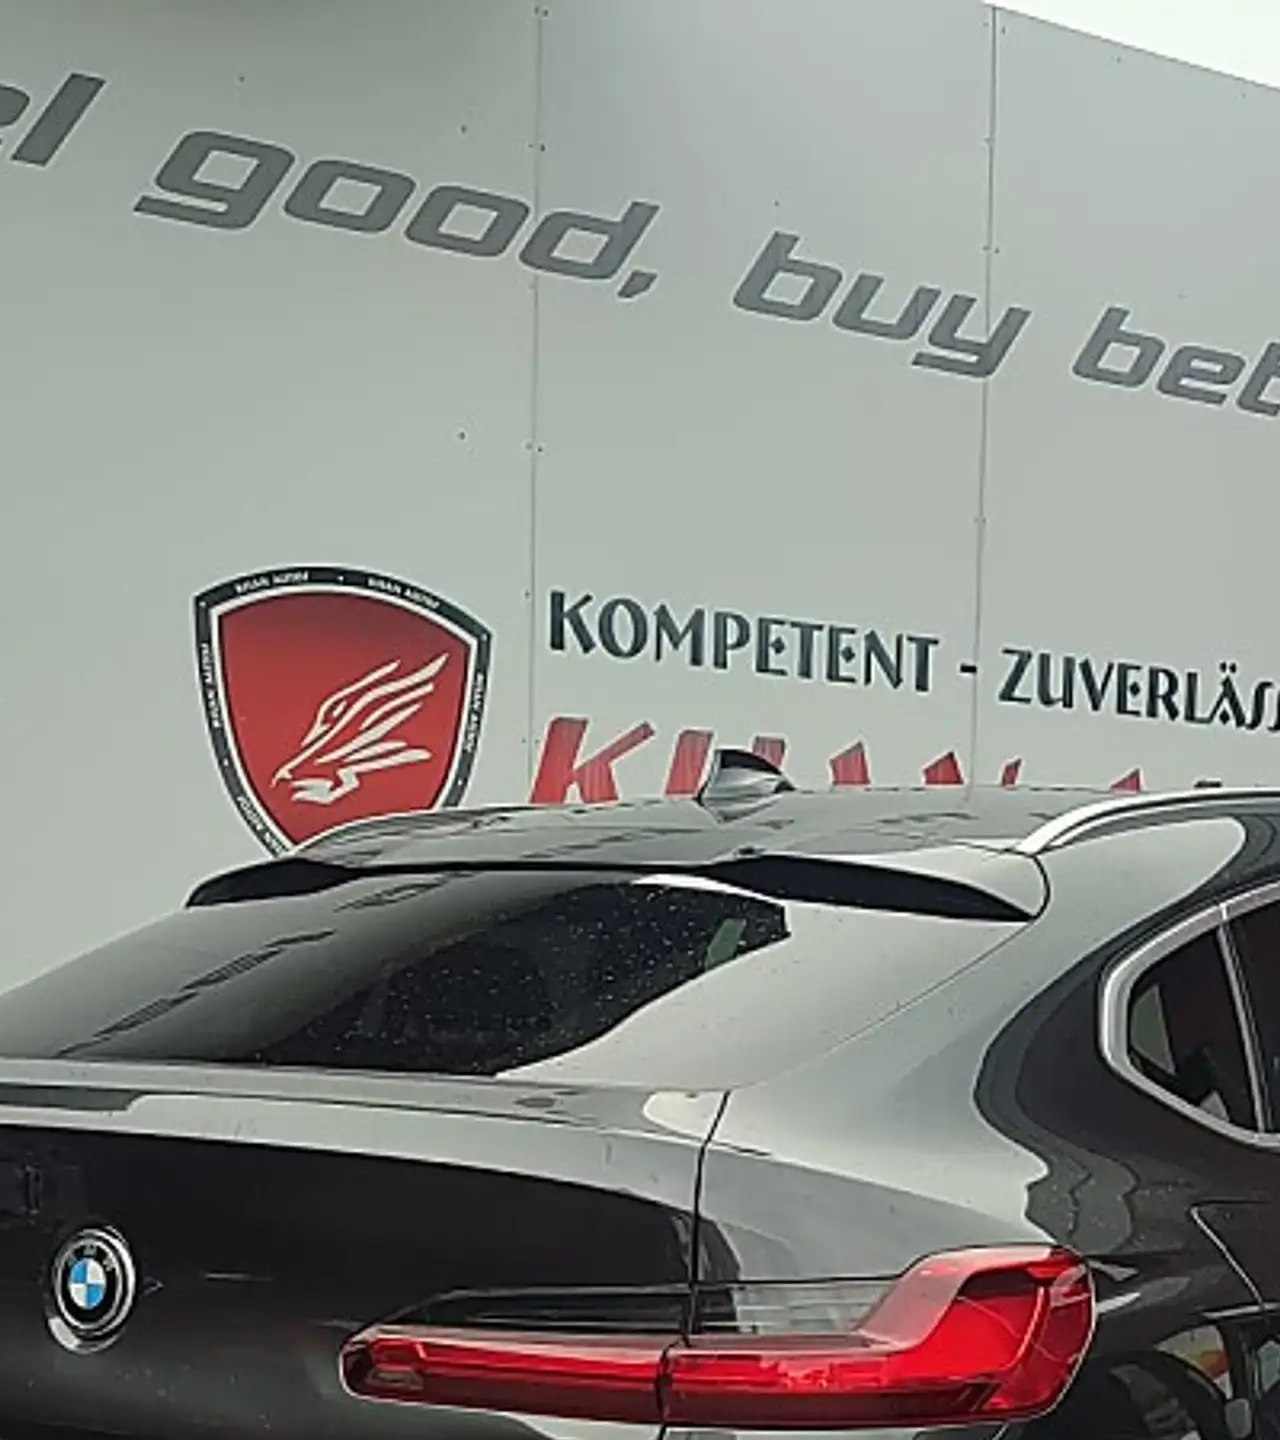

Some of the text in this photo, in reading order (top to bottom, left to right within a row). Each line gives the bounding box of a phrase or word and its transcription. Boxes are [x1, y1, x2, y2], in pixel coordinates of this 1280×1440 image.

[132, 130, 661, 300] good,
[732, 231, 1031, 378] buy
[549, 590, 940, 693] KOMPETENT
